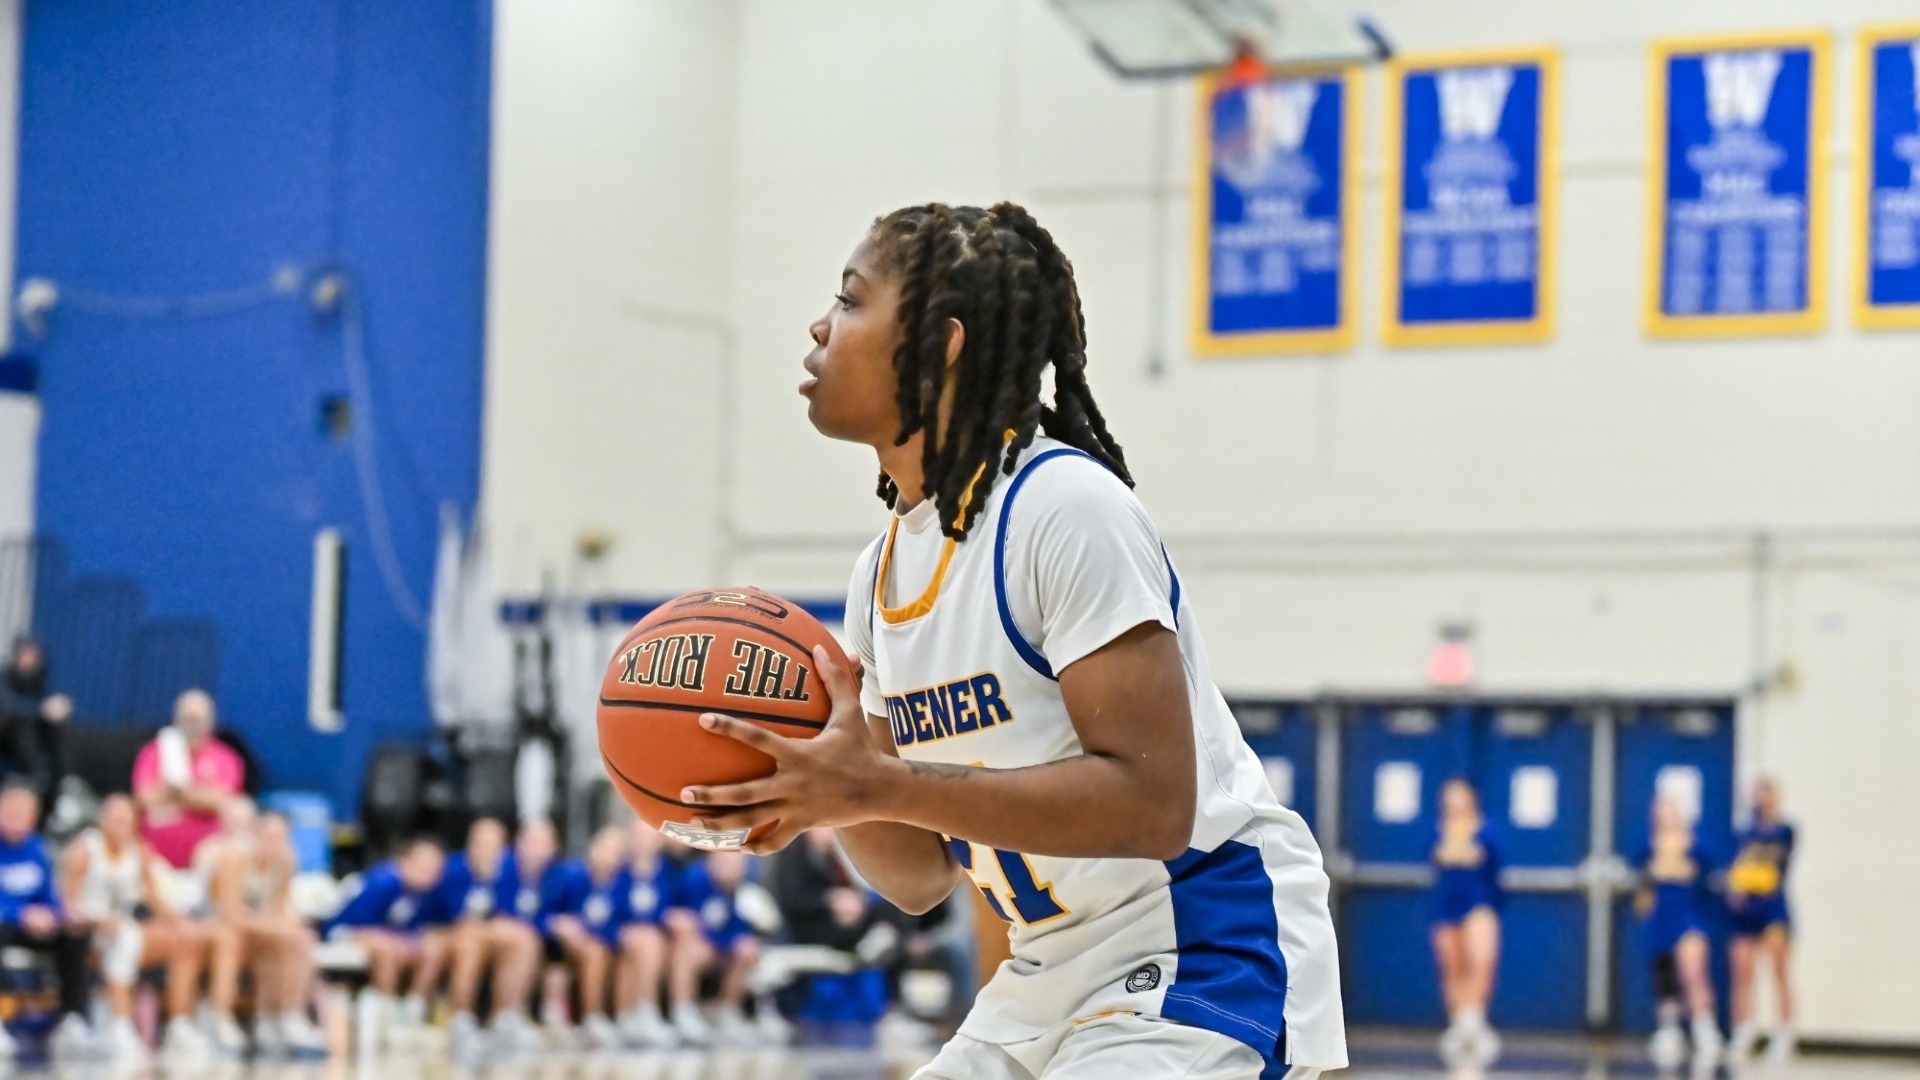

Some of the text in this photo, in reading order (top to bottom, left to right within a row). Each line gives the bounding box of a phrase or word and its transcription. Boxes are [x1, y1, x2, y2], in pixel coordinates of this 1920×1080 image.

[618, 633, 810, 702] THE ROCK
[882, 670, 1015, 749] IDENER
